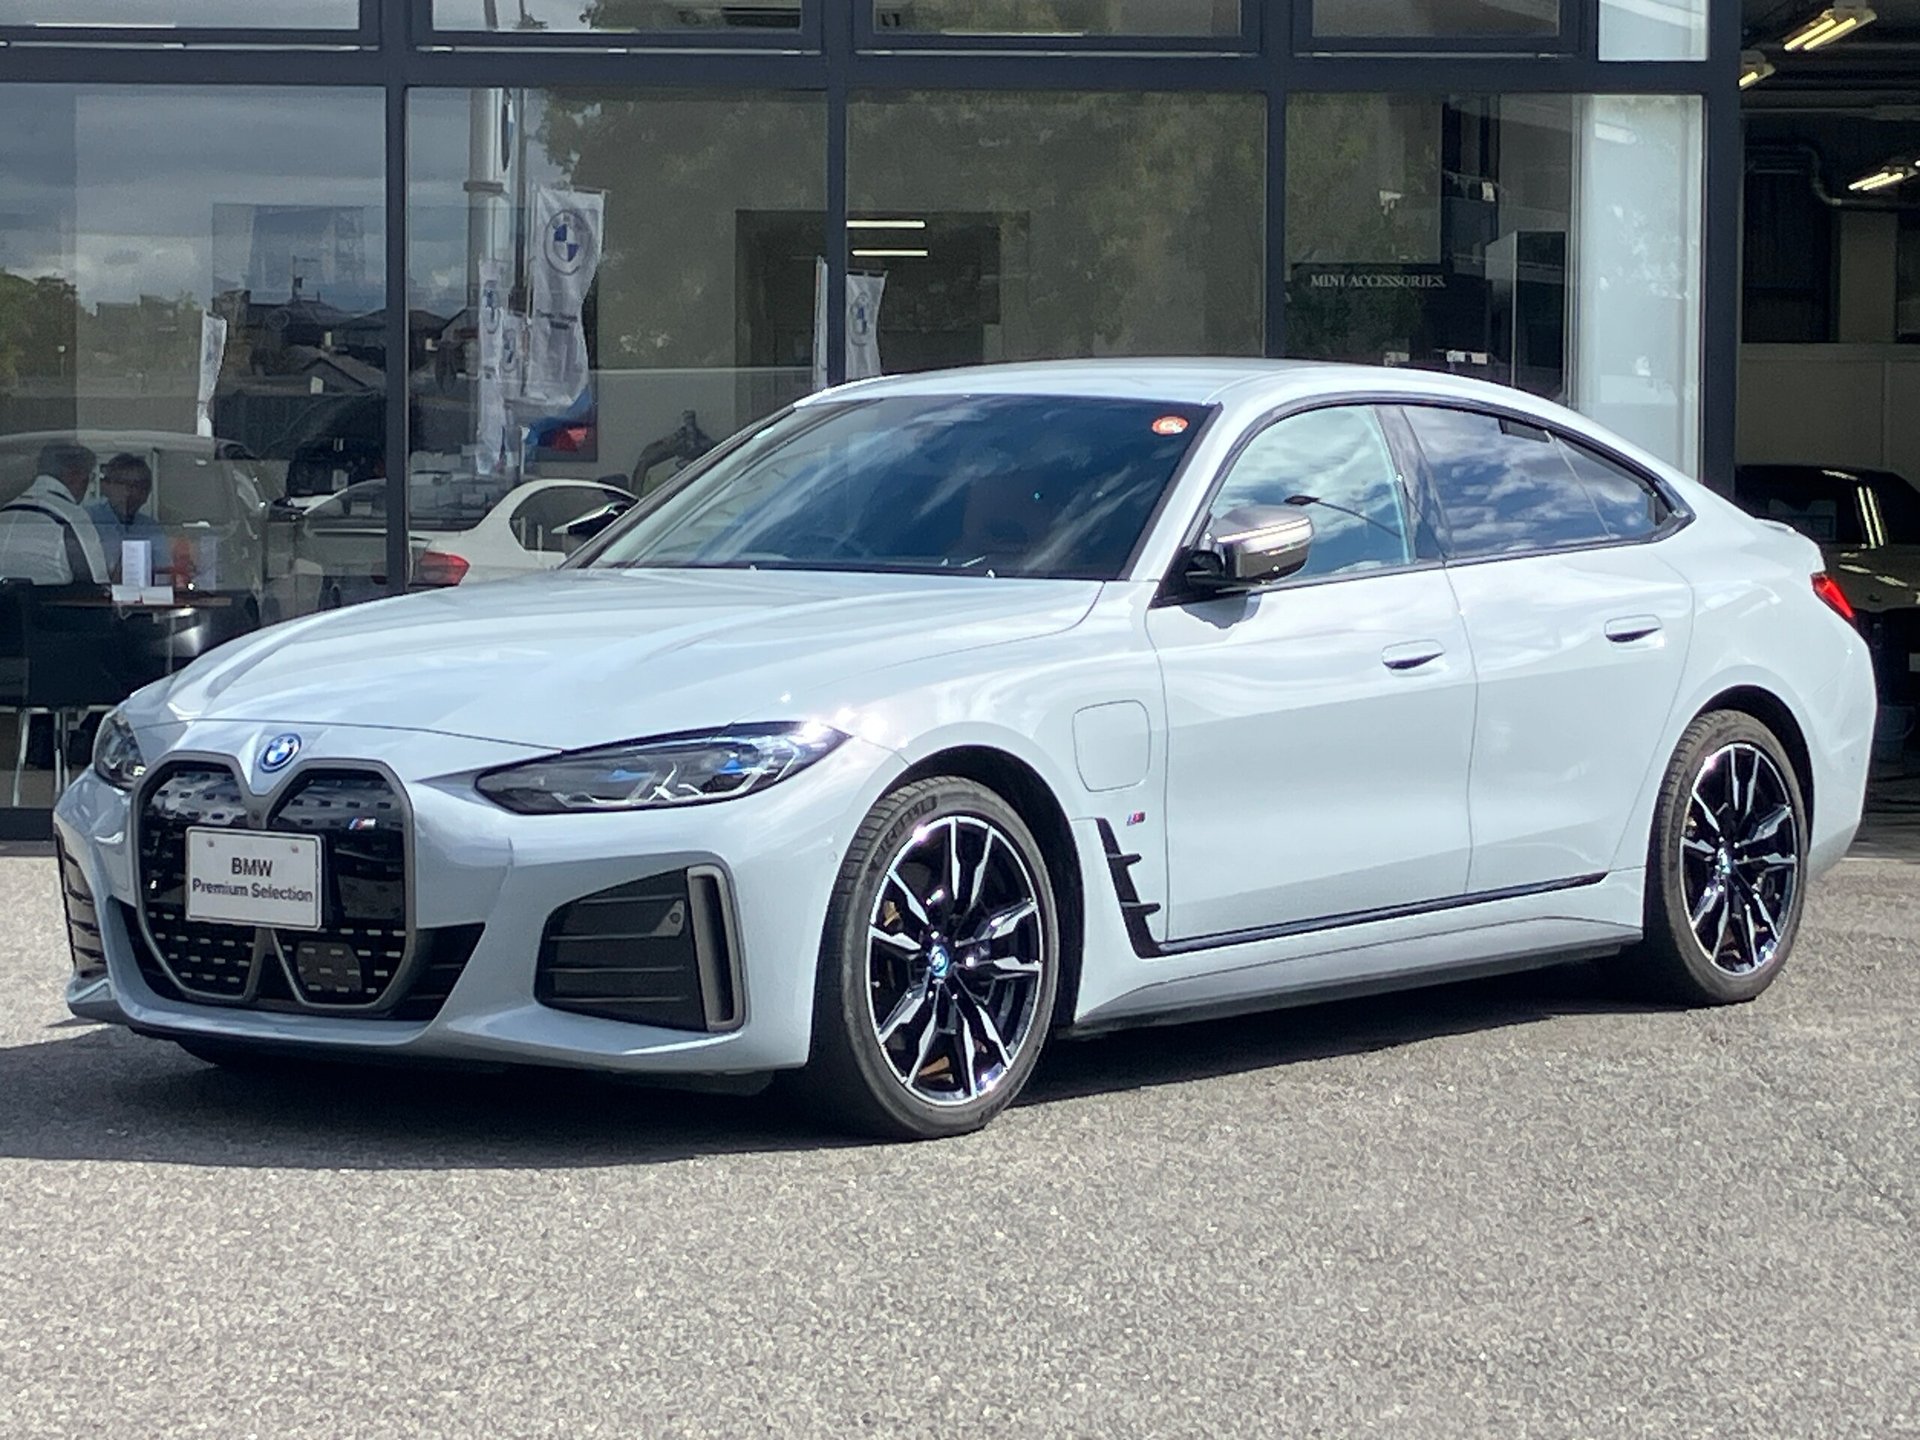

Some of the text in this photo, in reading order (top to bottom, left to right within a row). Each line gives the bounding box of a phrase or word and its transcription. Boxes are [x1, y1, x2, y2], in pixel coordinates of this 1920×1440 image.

[1310, 274, 1446, 288] MINI ACCESSORIES
[231, 857, 273, 877] BMW
[192, 878, 313, 903] Premium Selection
